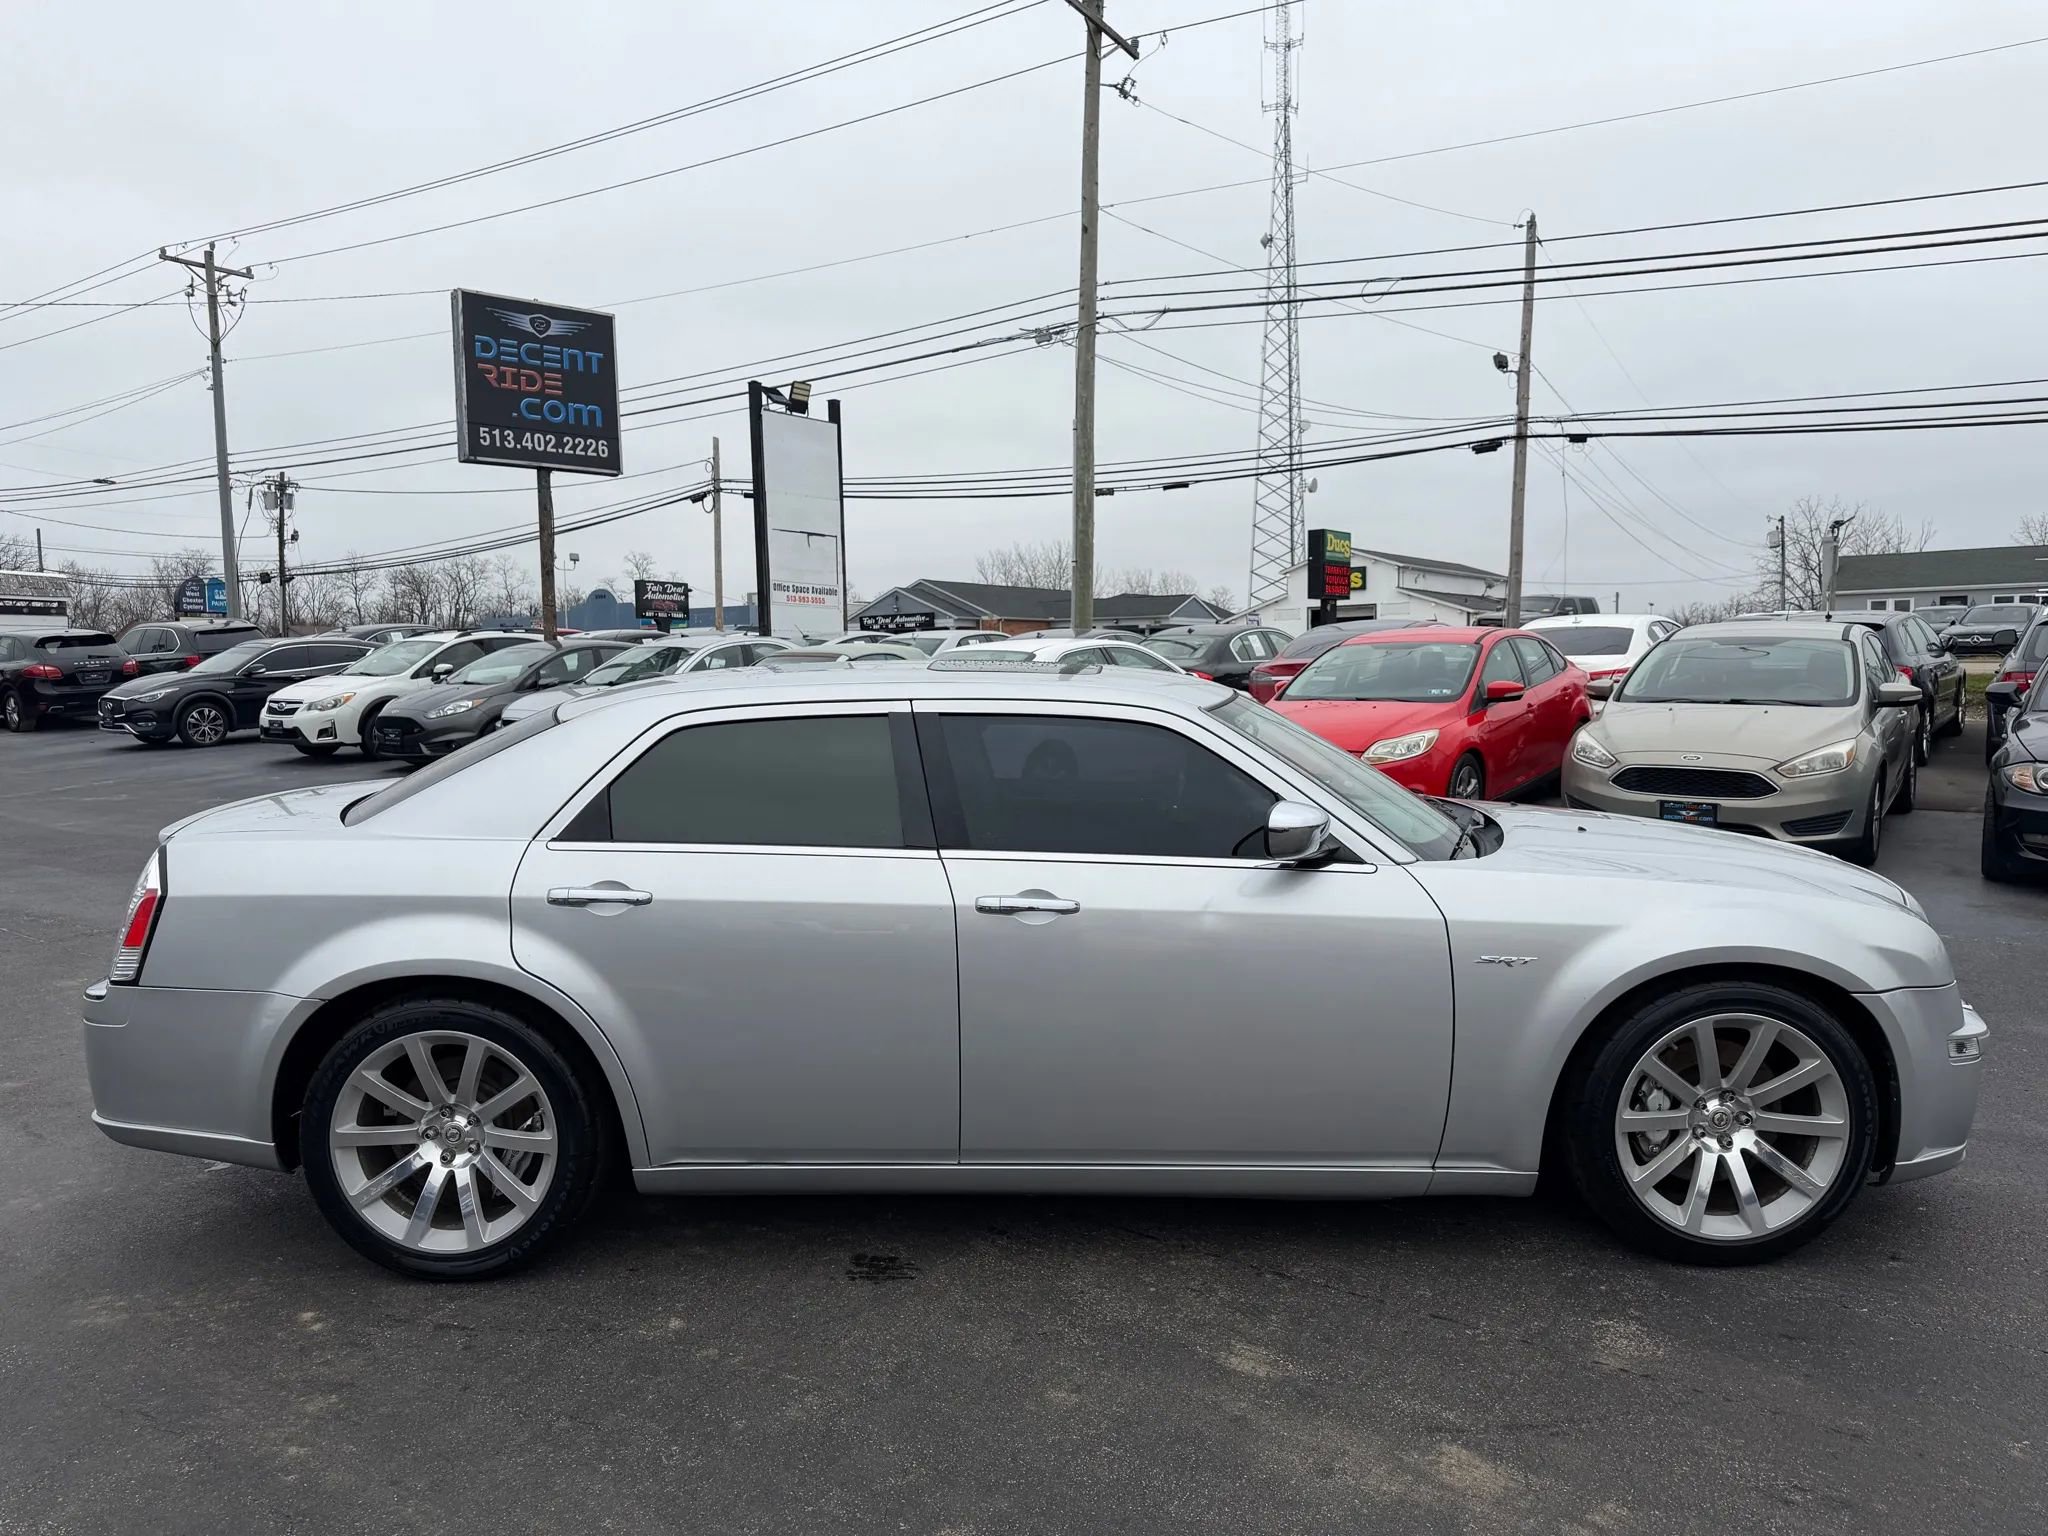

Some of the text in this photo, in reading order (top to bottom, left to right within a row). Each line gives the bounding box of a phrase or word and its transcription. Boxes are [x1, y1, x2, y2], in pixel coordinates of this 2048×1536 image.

[477, 363, 563, 395] RIDE
[479, 427, 609, 457] 513.402.2226
[645, 582, 685, 593] Fair Deal
[773, 583, 838, 596] Office Space Available
[643, 591, 686, 601] Automotive
